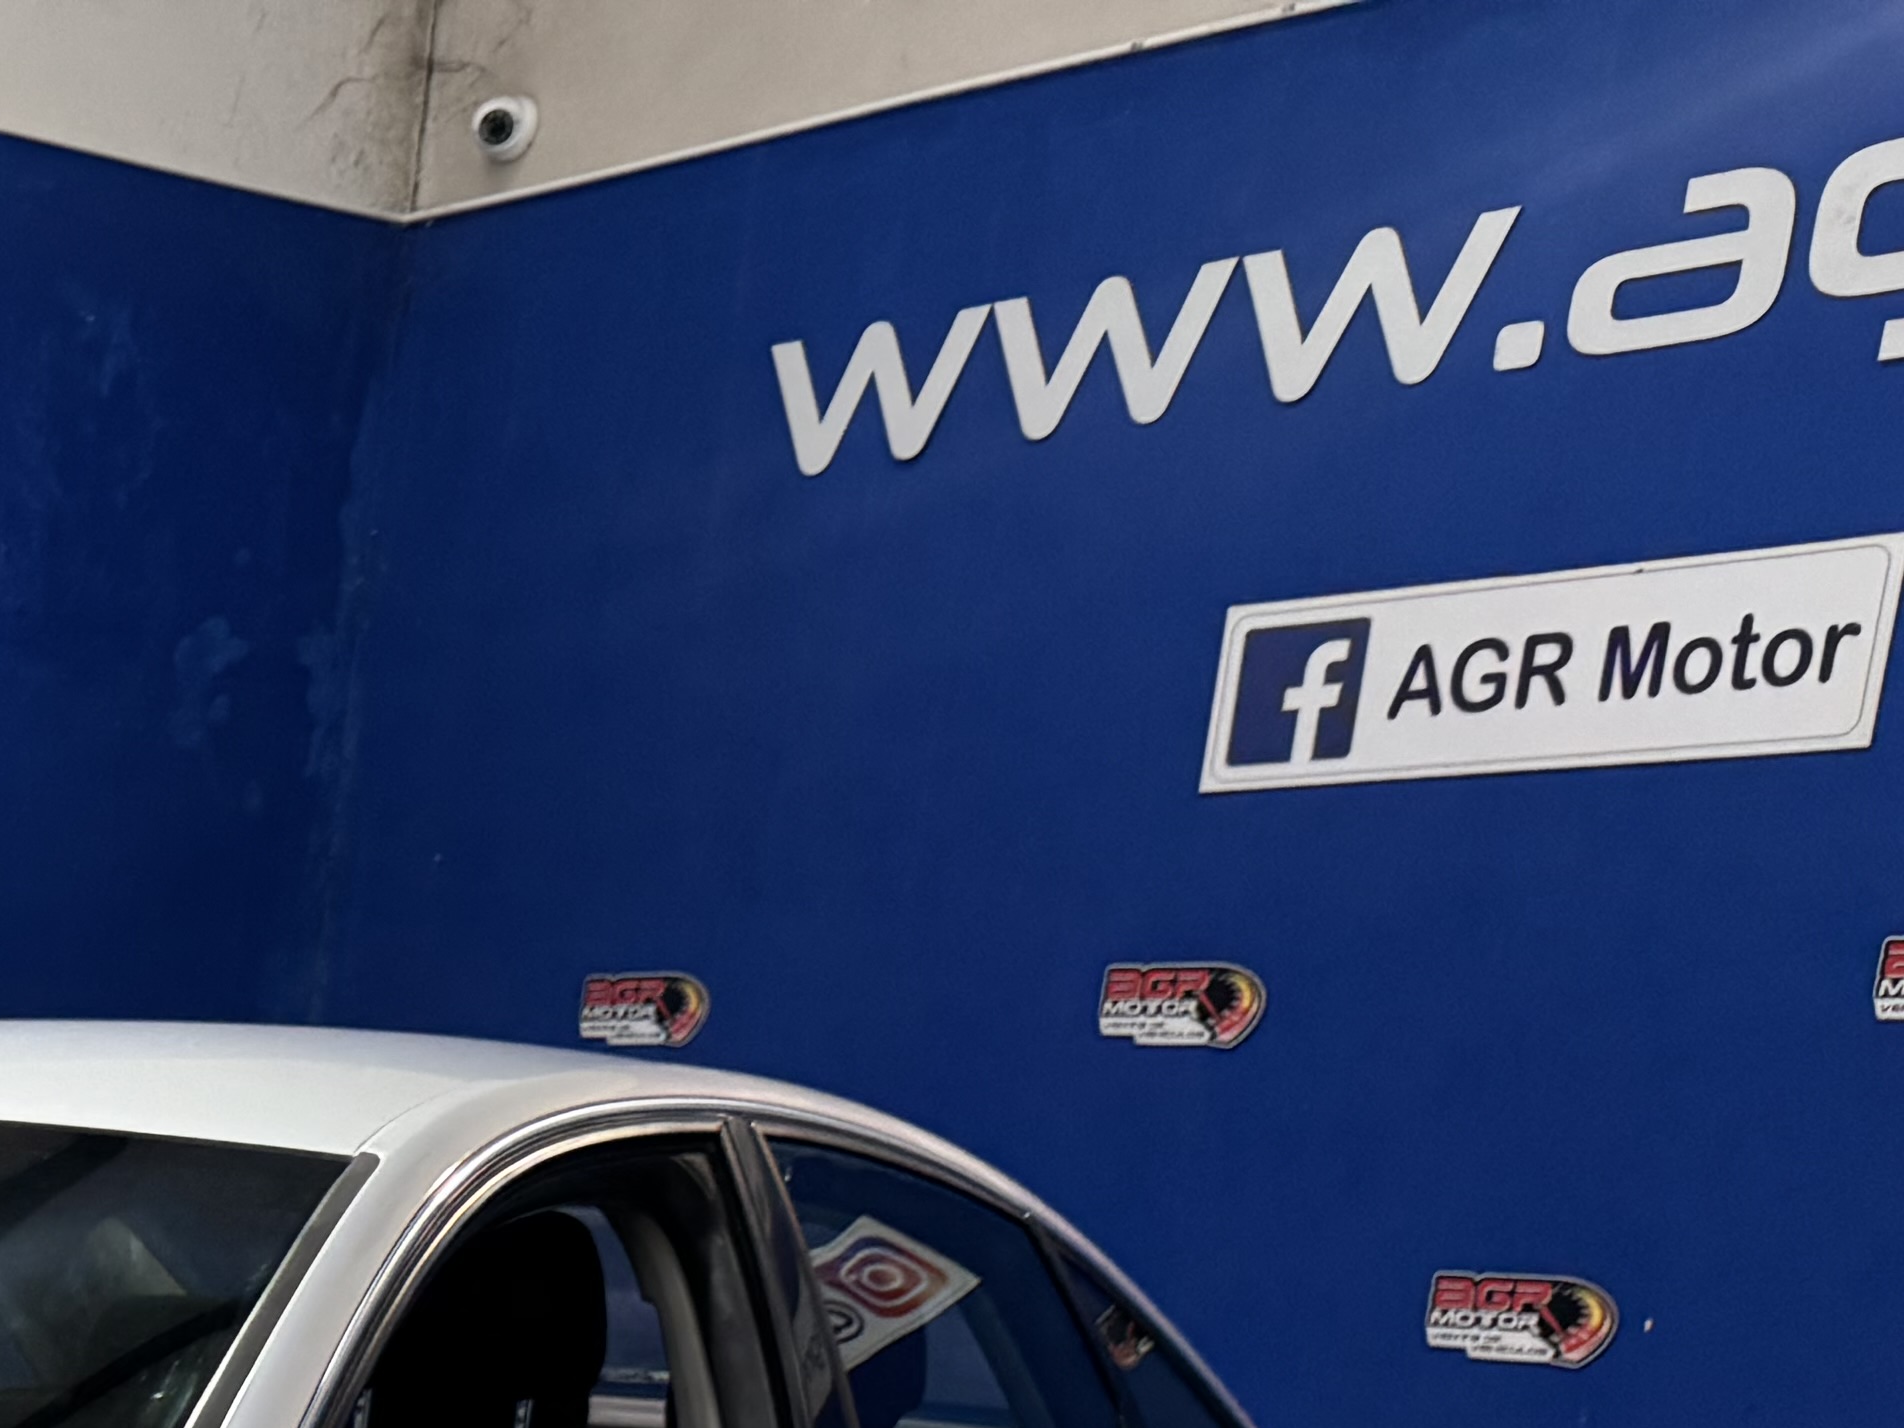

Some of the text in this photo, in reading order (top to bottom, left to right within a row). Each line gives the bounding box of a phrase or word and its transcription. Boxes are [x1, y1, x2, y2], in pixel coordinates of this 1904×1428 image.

[1387, 631, 1574, 720] AGR
[1598, 613, 1861, 702] Motor
[1103, 998, 1199, 1021] MOTOR
[1430, 1309, 1540, 1336] MOTOR
